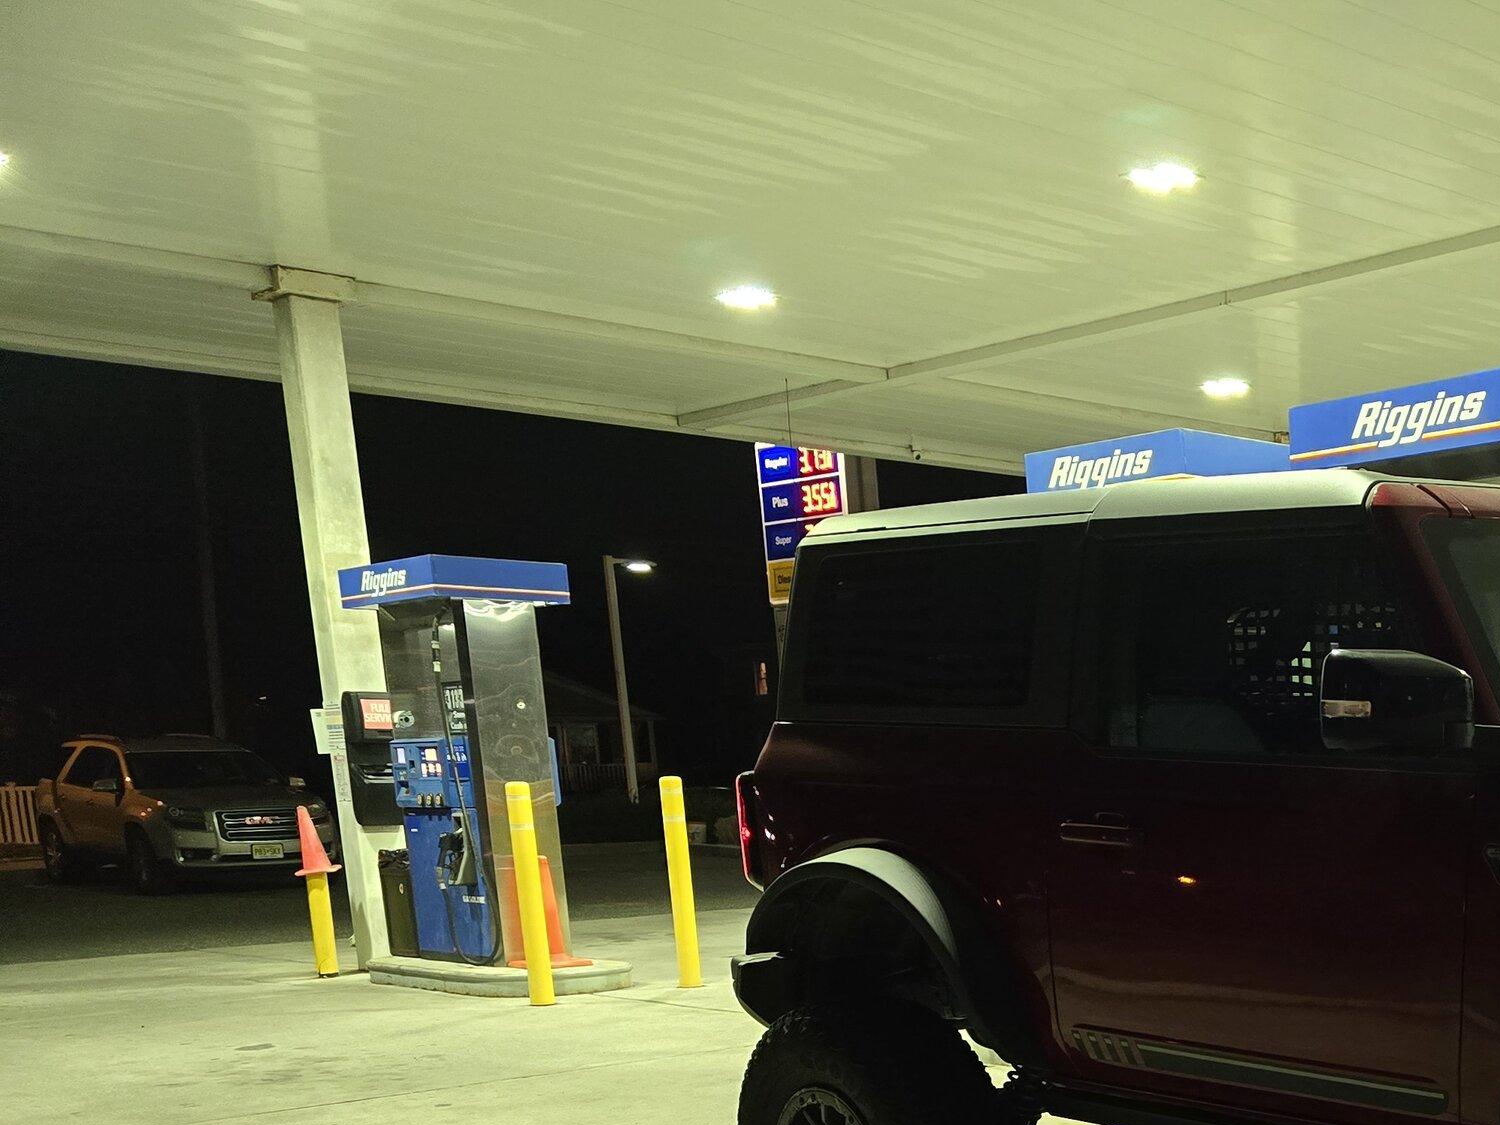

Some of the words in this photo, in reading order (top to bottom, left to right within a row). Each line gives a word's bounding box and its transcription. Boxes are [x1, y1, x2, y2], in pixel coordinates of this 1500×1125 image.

[1350, 391, 1487, 448] Riggins
[1048, 448, 1153, 490] Riggins
[771, 496, 789, 509] Plus
[774, 535, 792, 547] Super
[361, 567, 407, 598] Riggins
